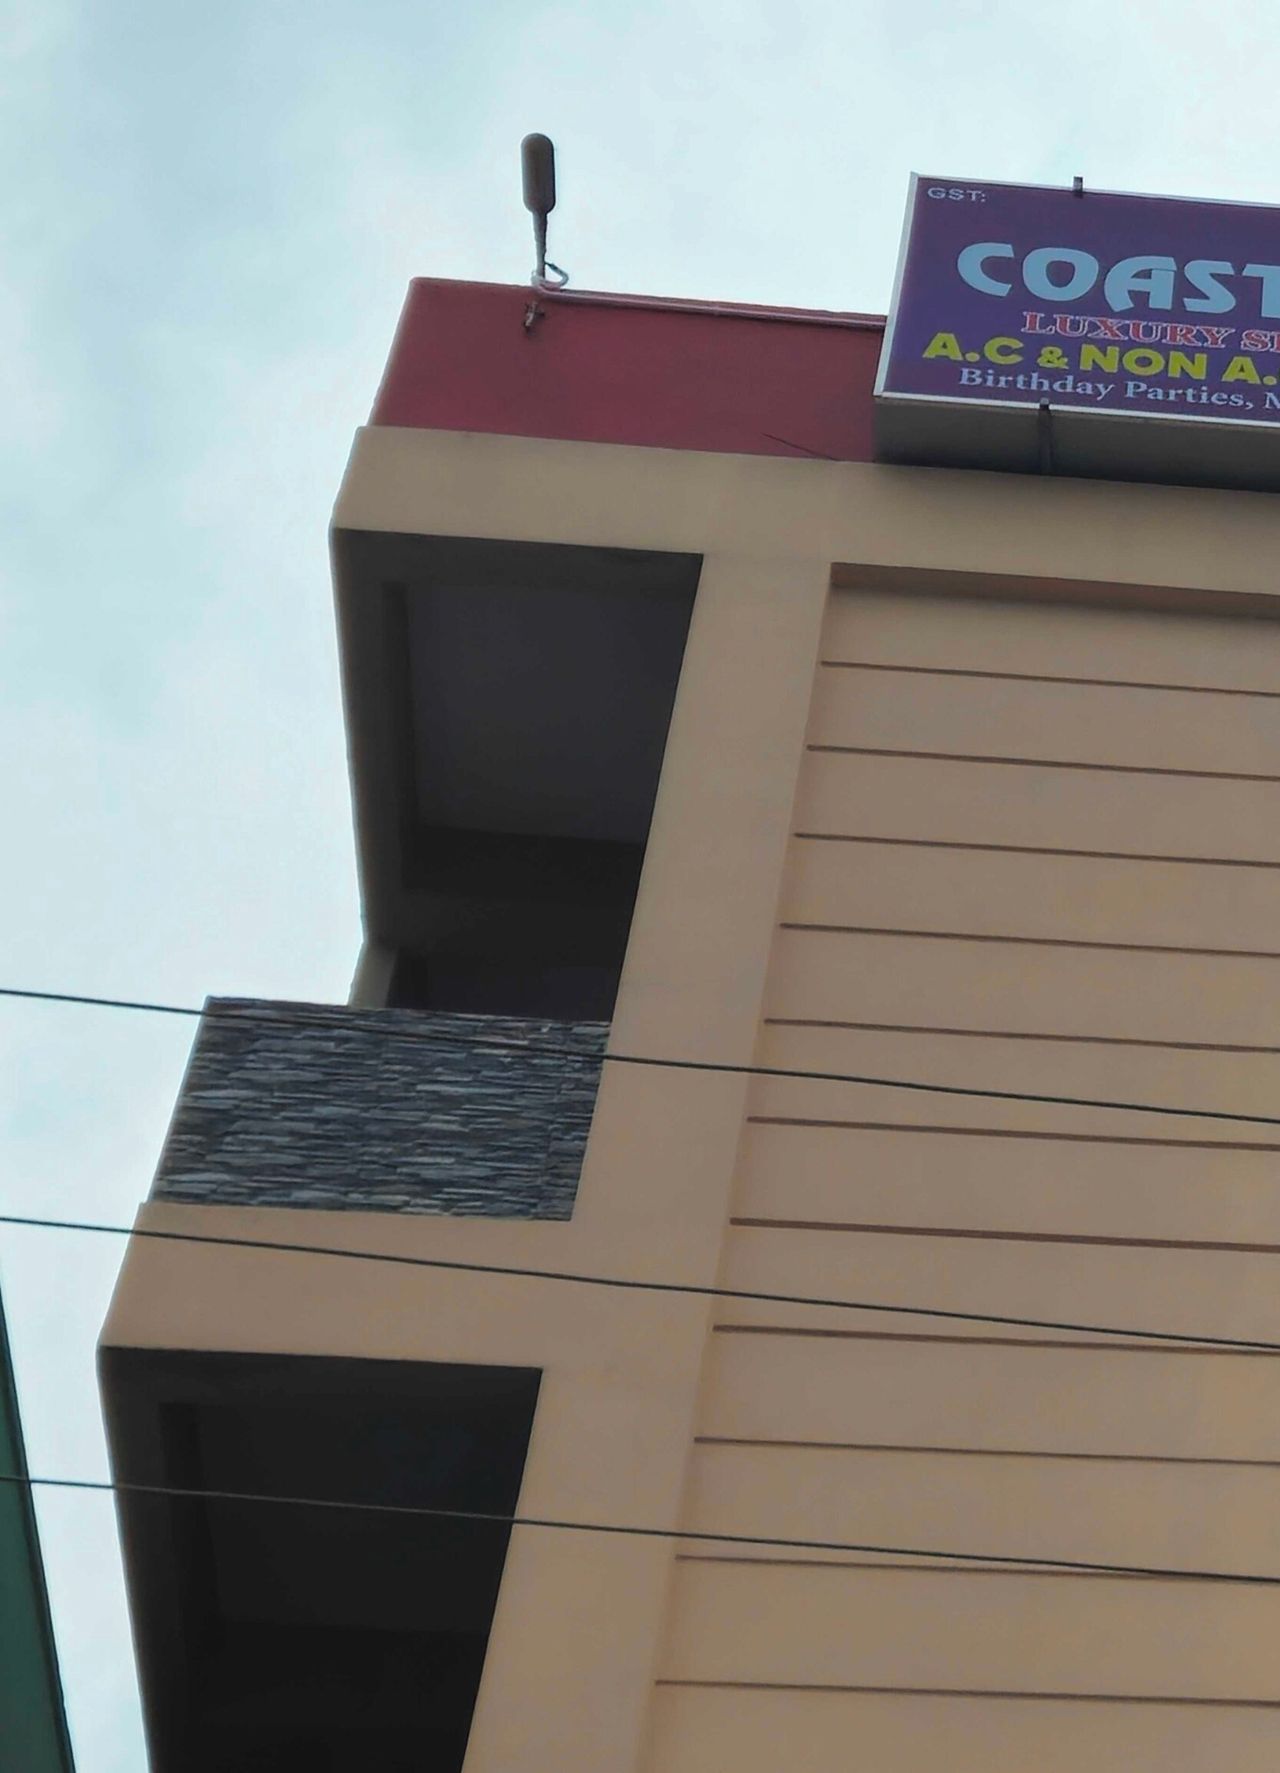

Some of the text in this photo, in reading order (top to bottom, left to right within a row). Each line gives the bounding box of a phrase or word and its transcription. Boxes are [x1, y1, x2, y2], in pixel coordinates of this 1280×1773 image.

[926, 186, 987, 202] GST:
[1021, 312, 1236, 348] LUXURY
[922, 332, 1024, 366] A.C
[1036, 346, 1070, 370] &
[1080, 343, 1208, 380] NON
[958, 367, 1116, 402] Birthday
[1125, 380, 1255, 411] Parties,
